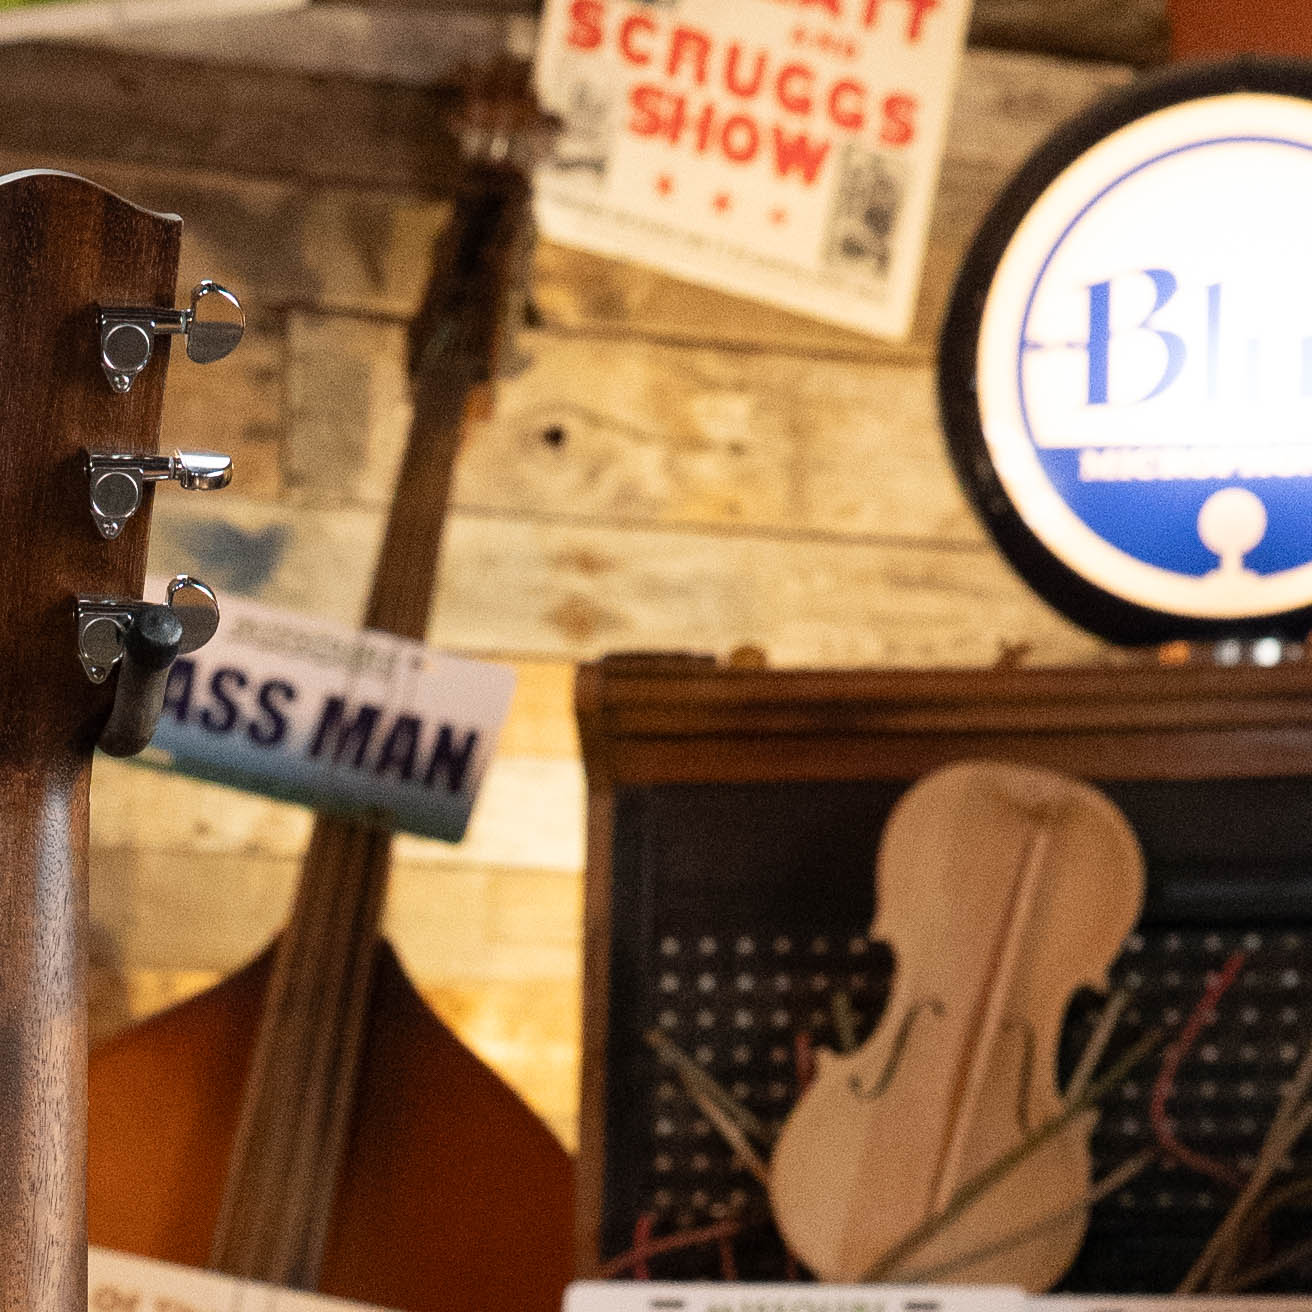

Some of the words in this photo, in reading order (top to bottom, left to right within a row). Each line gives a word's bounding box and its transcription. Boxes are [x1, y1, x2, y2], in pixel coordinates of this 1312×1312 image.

[567, 0, 918, 147] SCRUGGS
[628, 83, 830, 185] SHOW
[163, 657, 298, 746] ASS
[308, 694, 478, 795] MAN
